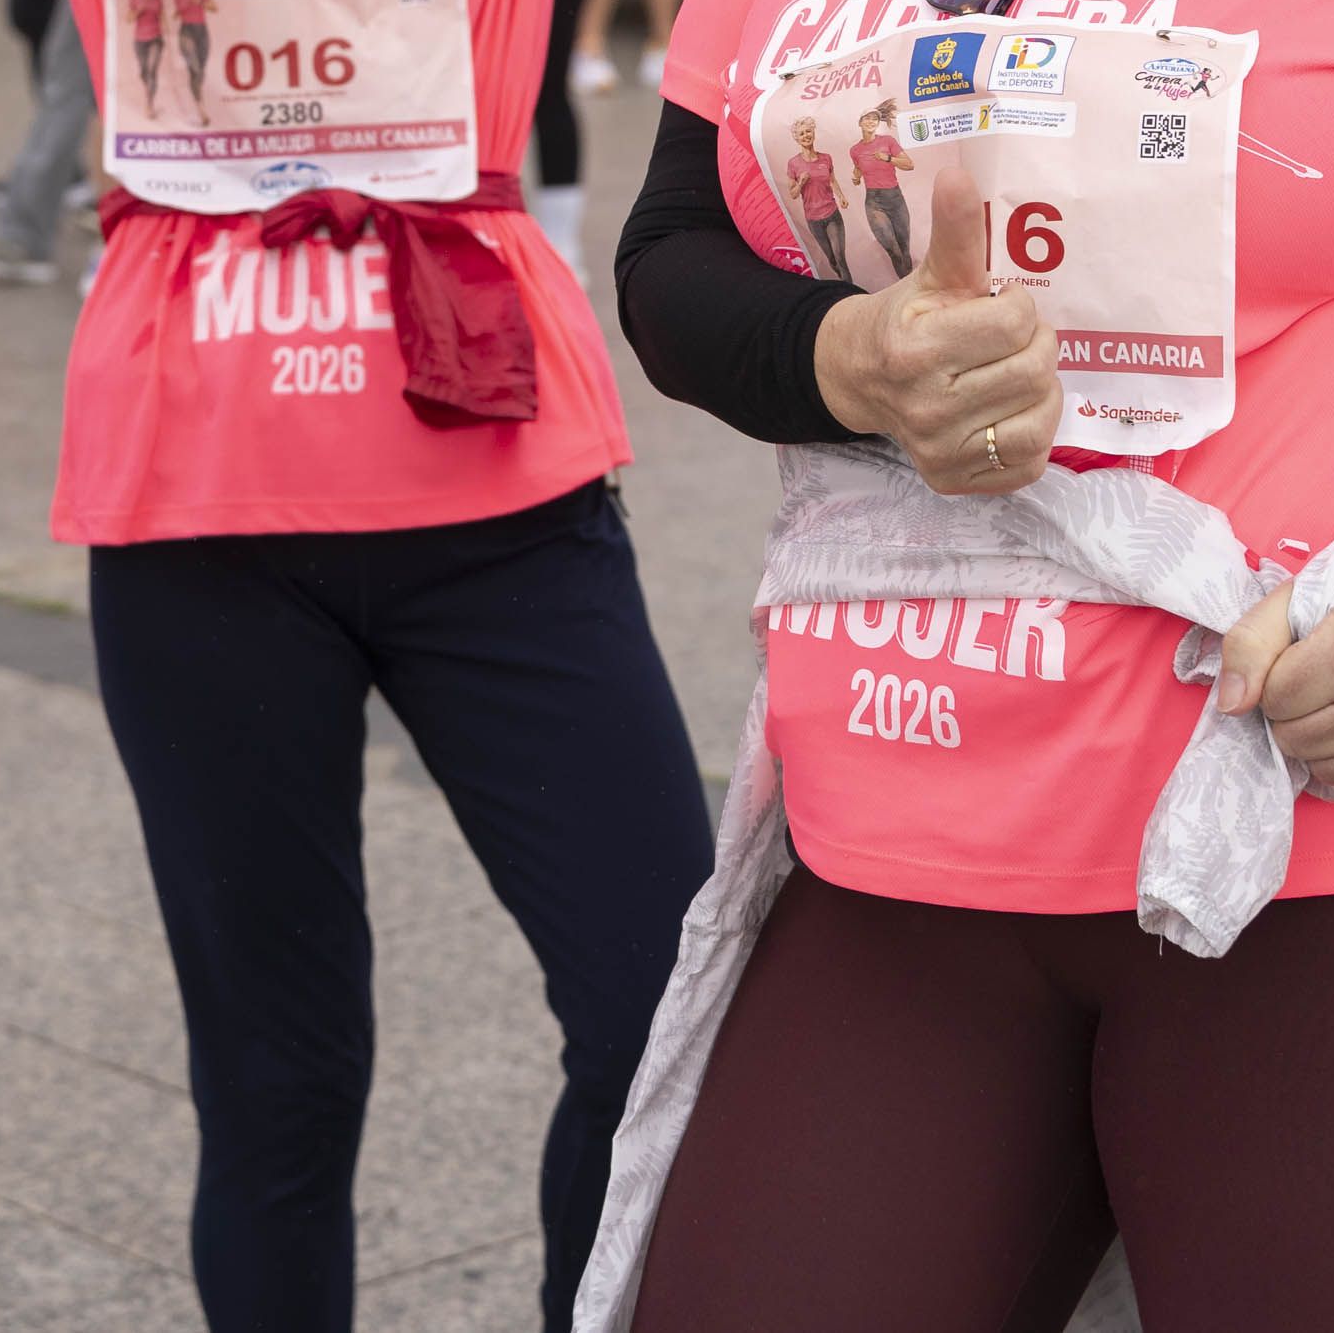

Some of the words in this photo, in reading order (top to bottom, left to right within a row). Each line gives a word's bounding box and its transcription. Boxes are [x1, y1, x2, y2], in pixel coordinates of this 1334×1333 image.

[223, 37, 355, 92] 016
[805, 72, 825, 84] TU
[829, 50, 884, 79] DORSAL
[801, 65, 883, 100] SUMA
[917, 73, 950, 86] Cabildo
[951, 71, 963, 82] de
[997, 71, 1028, 79] INSTITUTO
[1030, 71, 1058, 80] INSULAR
[1009, 78, 1054, 89] DEPORTES
[1134, 71, 1182, 86] Carrera
[914, 84, 939, 96] Gran
[940, 80, 970, 94] Canaria
[1158, 83, 1193, 101] Mujer
[260, 102, 323, 127] 2380
[122, 138, 205, 158] CARRERA
[206, 137, 229, 156] DE
[231, 136, 254, 156] LA
[256, 133, 315, 155] MUJER
[329, 130, 376, 151] GRAN
[380, 125, 456, 148] CANARIA
[943, 128, 958, 137] Gran
[992, 278, 1005, 287] DE
[1059, 340, 1091, 363] AN
[1098, 341, 1205, 369] CANARIA
[272, 344, 365, 395] 2026
[1099, 404, 1180, 423] Santander
[848, 668, 961, 748] 2026
